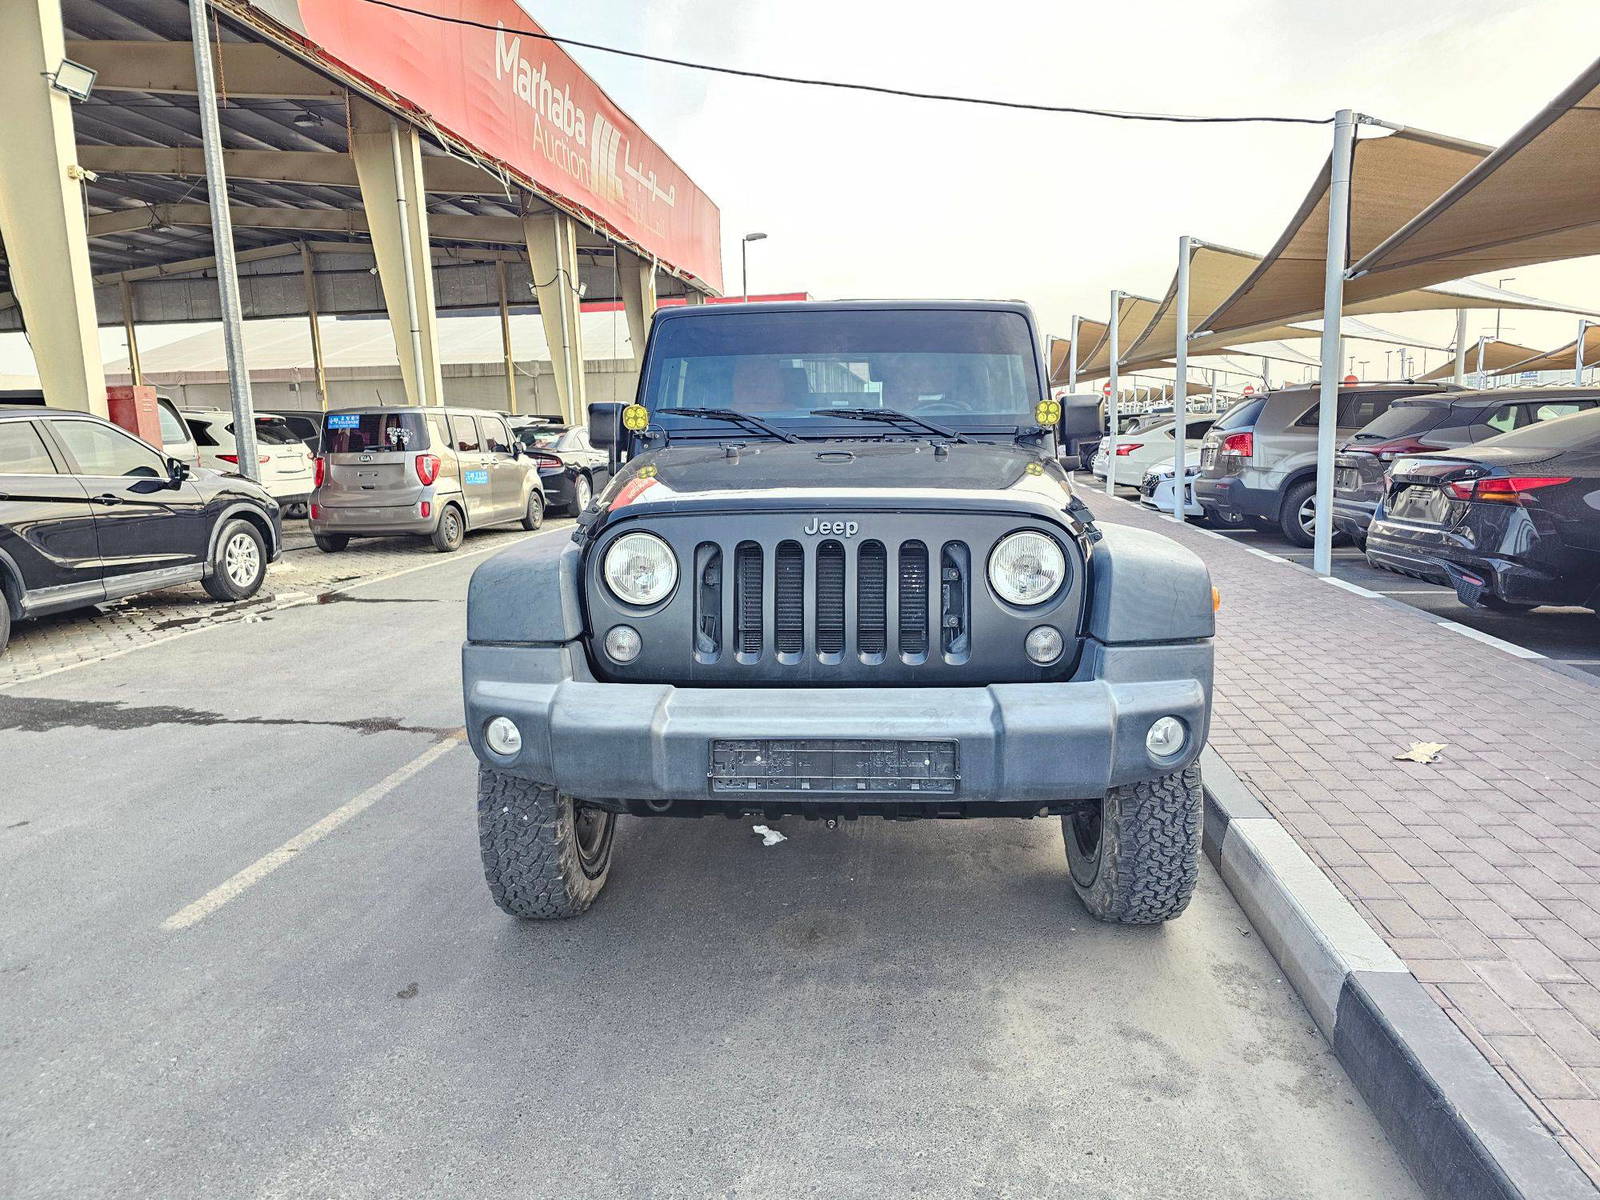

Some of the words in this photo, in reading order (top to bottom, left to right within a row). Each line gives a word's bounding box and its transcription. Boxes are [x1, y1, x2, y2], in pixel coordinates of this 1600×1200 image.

[494, 20, 586, 147] Marhaba
[533, 114, 590, 188] Auction
[804, 517, 859, 538] Jeep
